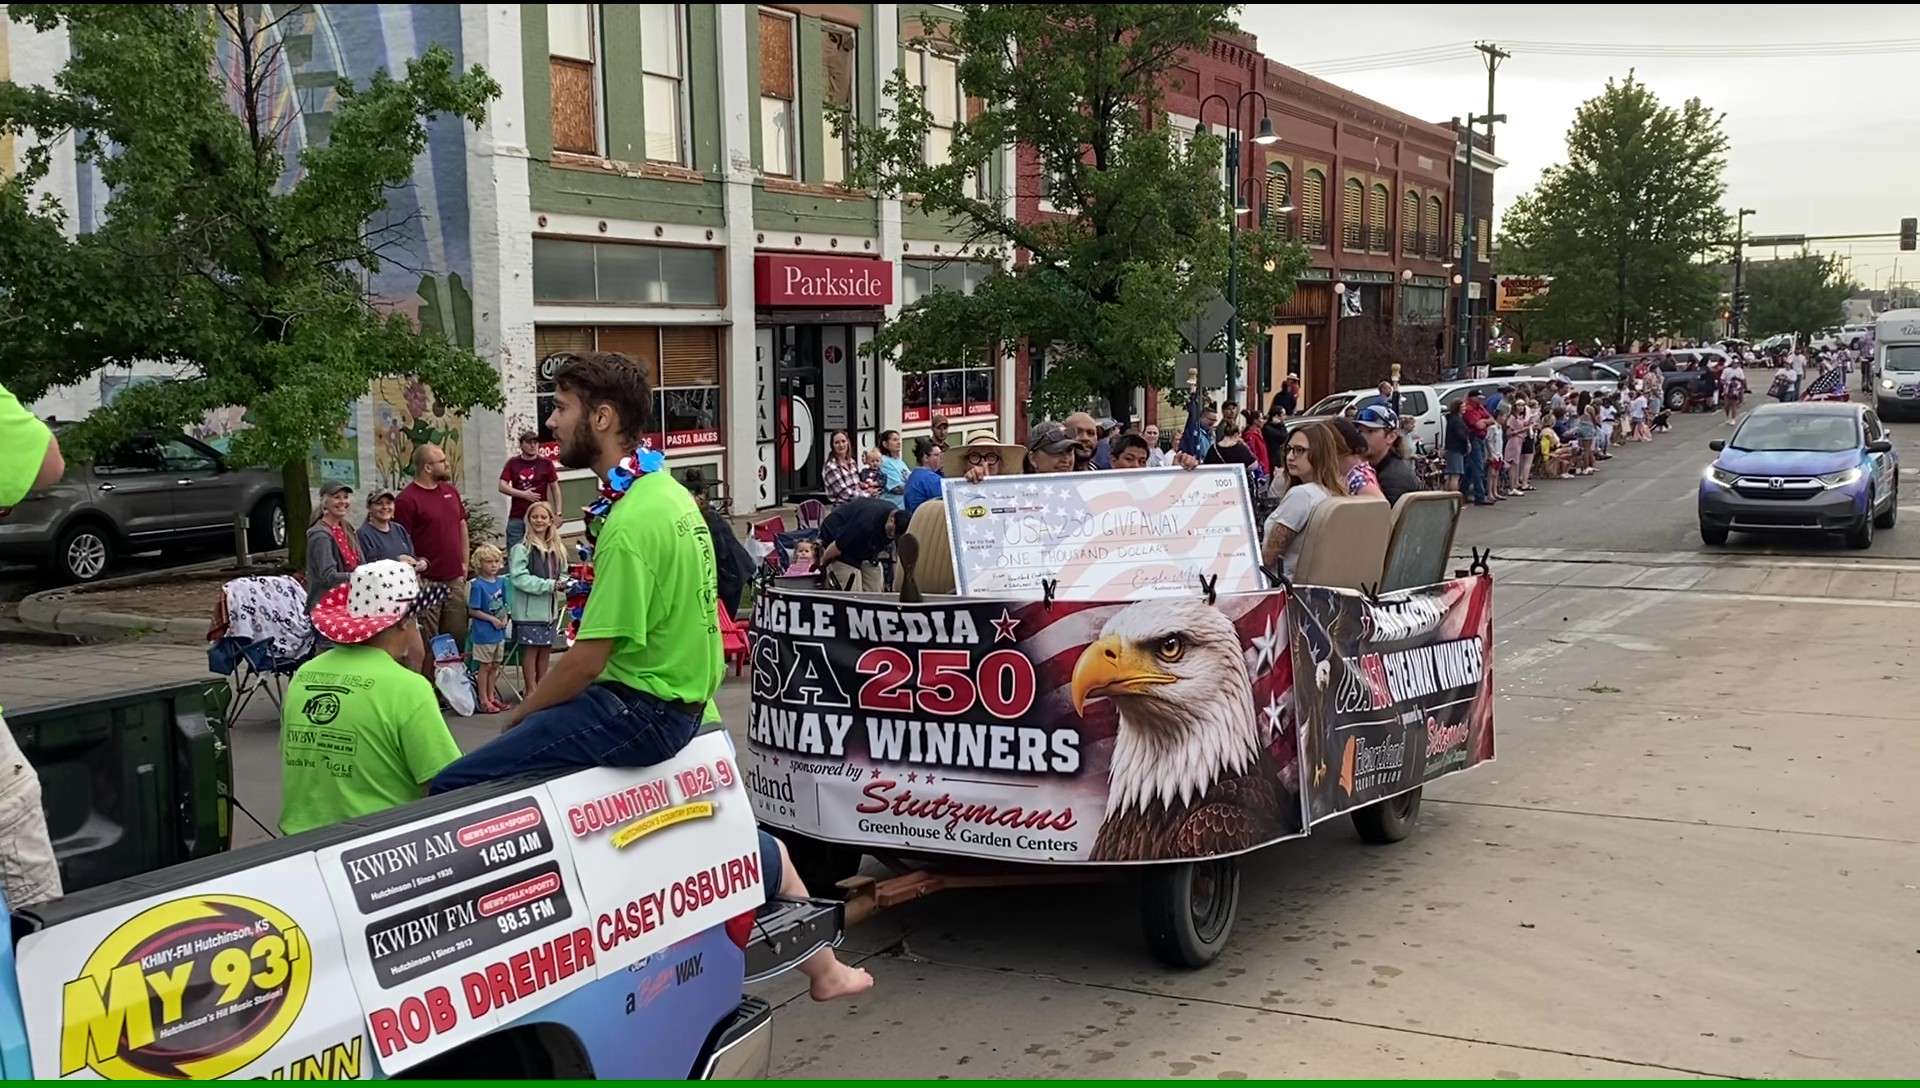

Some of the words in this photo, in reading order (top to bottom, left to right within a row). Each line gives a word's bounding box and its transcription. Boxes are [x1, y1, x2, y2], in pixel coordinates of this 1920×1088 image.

[783, 264, 883, 297] Parkside
[667, 434, 691, 445] PASTA
[693, 432, 718, 443] BAKES
[1214, 479, 1233, 487] 1001
[1002, 515, 1054, 545] USA
[1056, 512, 1095, 539] 250
[1101, 509, 1179, 536] GIVEAWAY
[996, 551, 1031, 568] ONE
[1040, 547, 1109, 564] THOUSAND
[1117, 543, 1169, 559] DOLLARS
[755, 594, 836, 638] EAGLE
[846, 606, 980, 644] MEDIA
[749, 631, 851, 708] SA
[855, 646, 1036, 719] 250
[866, 717, 1080, 774] WINNERS
[790, 759, 845, 777] sponsored
[846, 763, 864, 782] by
[567, 778, 671, 837] COUNTRY
[674, 758, 734, 800] 102.9
[856, 779, 1078, 832] Stutzmans
[479, 840, 517, 867] 1450
[519, 831, 542, 856] AM
[858, 817, 940, 841] Greenhouse
[945, 827, 957, 841] &
[960, 828, 1012, 849] Garden
[1017, 834, 1079, 853] Centers
[348, 842, 418, 885] KWBW
[424, 831, 459, 862] AM
[371, 880, 412, 901] Hutchinson
[416, 873, 436, 887] Since
[597, 888, 666, 952] CASEY
[670, 851, 761, 919] OSBURN
[370, 912, 441, 959] KWBW
[443, 900, 479, 932] FM
[497, 907, 531, 934] 98.5
[533, 898, 556, 922] FM
[141, 942, 193, 970] KHMY-FM
[194, 926, 254, 953] Hutchinson,
[254, 918, 270, 934] KS
[390, 953, 431, 976] Hutchinson
[436, 945, 456, 959] Since
[456, 937, 473, 951] 2013
[369, 985, 458, 1058] ROB
[461, 927, 597, 1020] DREHER
[625, 991, 636, 1016] a
[675, 951, 704, 987] WAY.
[60, 959, 195, 1079] MY
[160, 1013, 215, 1039] Hutchinson's
[216, 1007, 228, 1020] Hit
[229, 999, 254, 1014] Music
